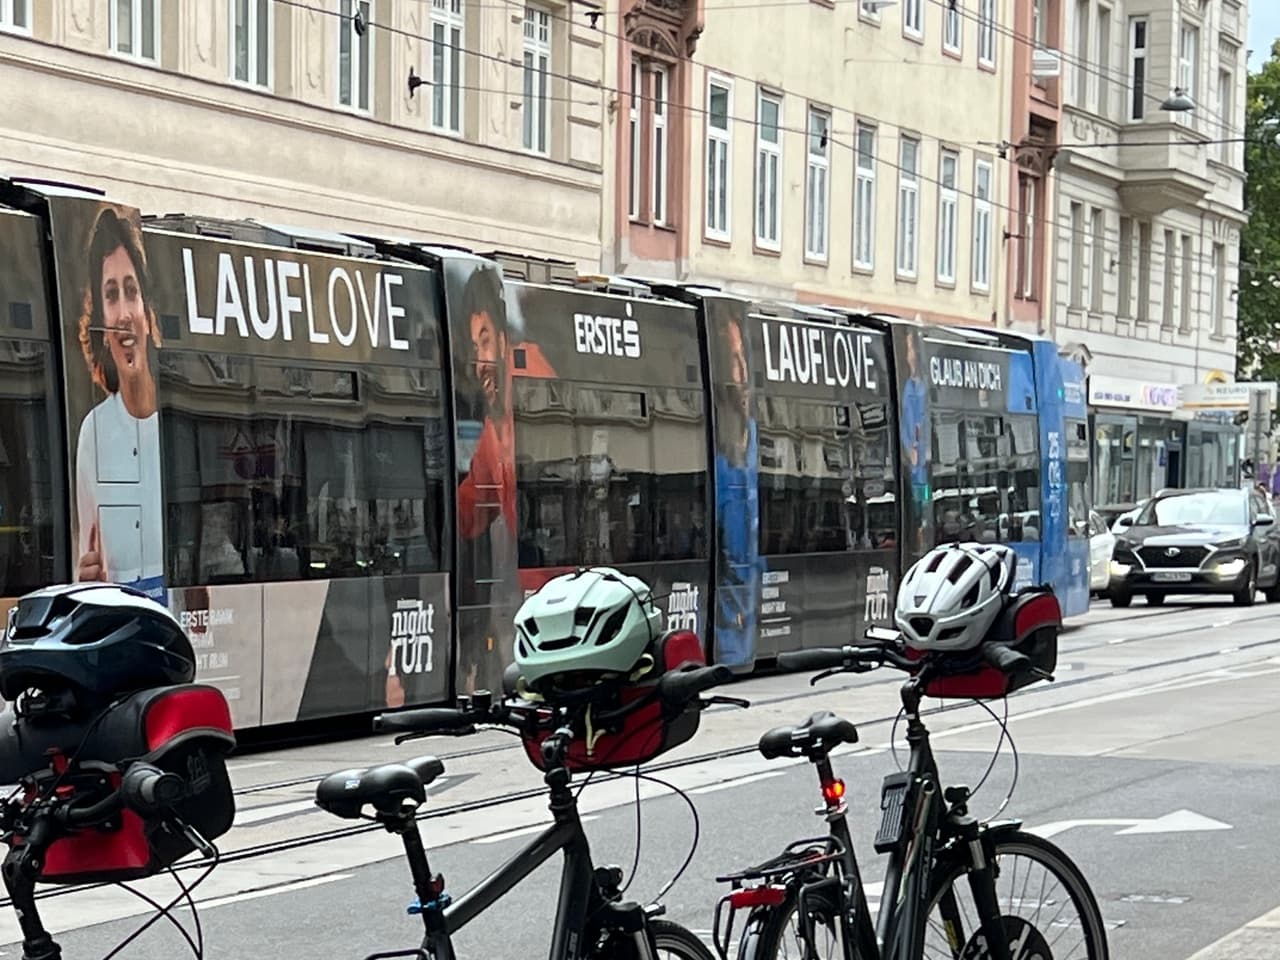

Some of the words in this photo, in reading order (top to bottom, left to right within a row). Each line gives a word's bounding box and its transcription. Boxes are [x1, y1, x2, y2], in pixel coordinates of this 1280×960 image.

[182, 247, 409, 350] LAUFLOVE
[574, 313, 623, 357] ERSTE
[930, 356, 964, 388] GLAUB
[391, 600, 435, 644] night
[388, 634, 433, 677] run
